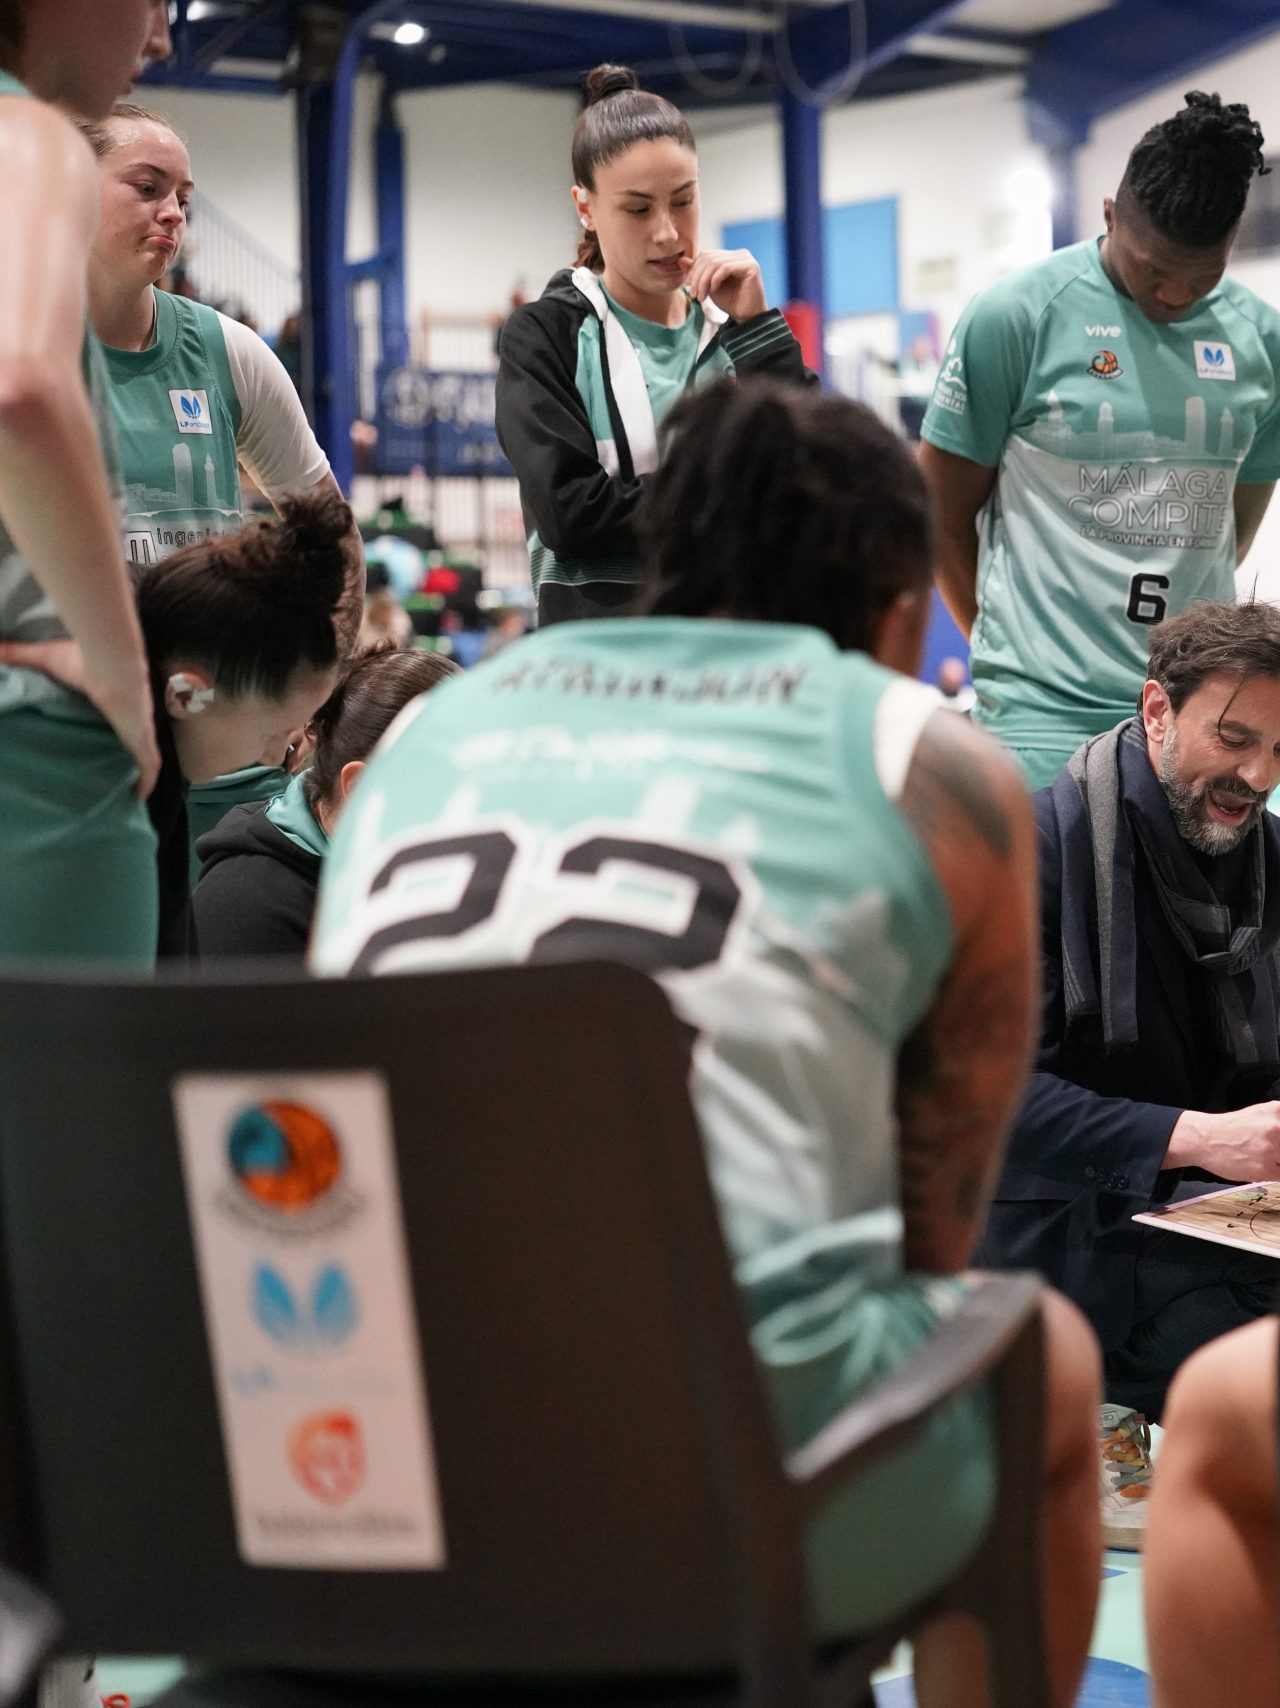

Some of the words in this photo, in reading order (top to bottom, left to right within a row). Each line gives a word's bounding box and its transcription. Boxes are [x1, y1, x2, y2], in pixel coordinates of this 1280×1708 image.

[1085, 324, 1122, 337] vive
[1079, 462, 1231, 499] MÁLAGA
[1100, 529, 1166, 547] PROVINCIA
[1126, 572, 1171, 625] 6
